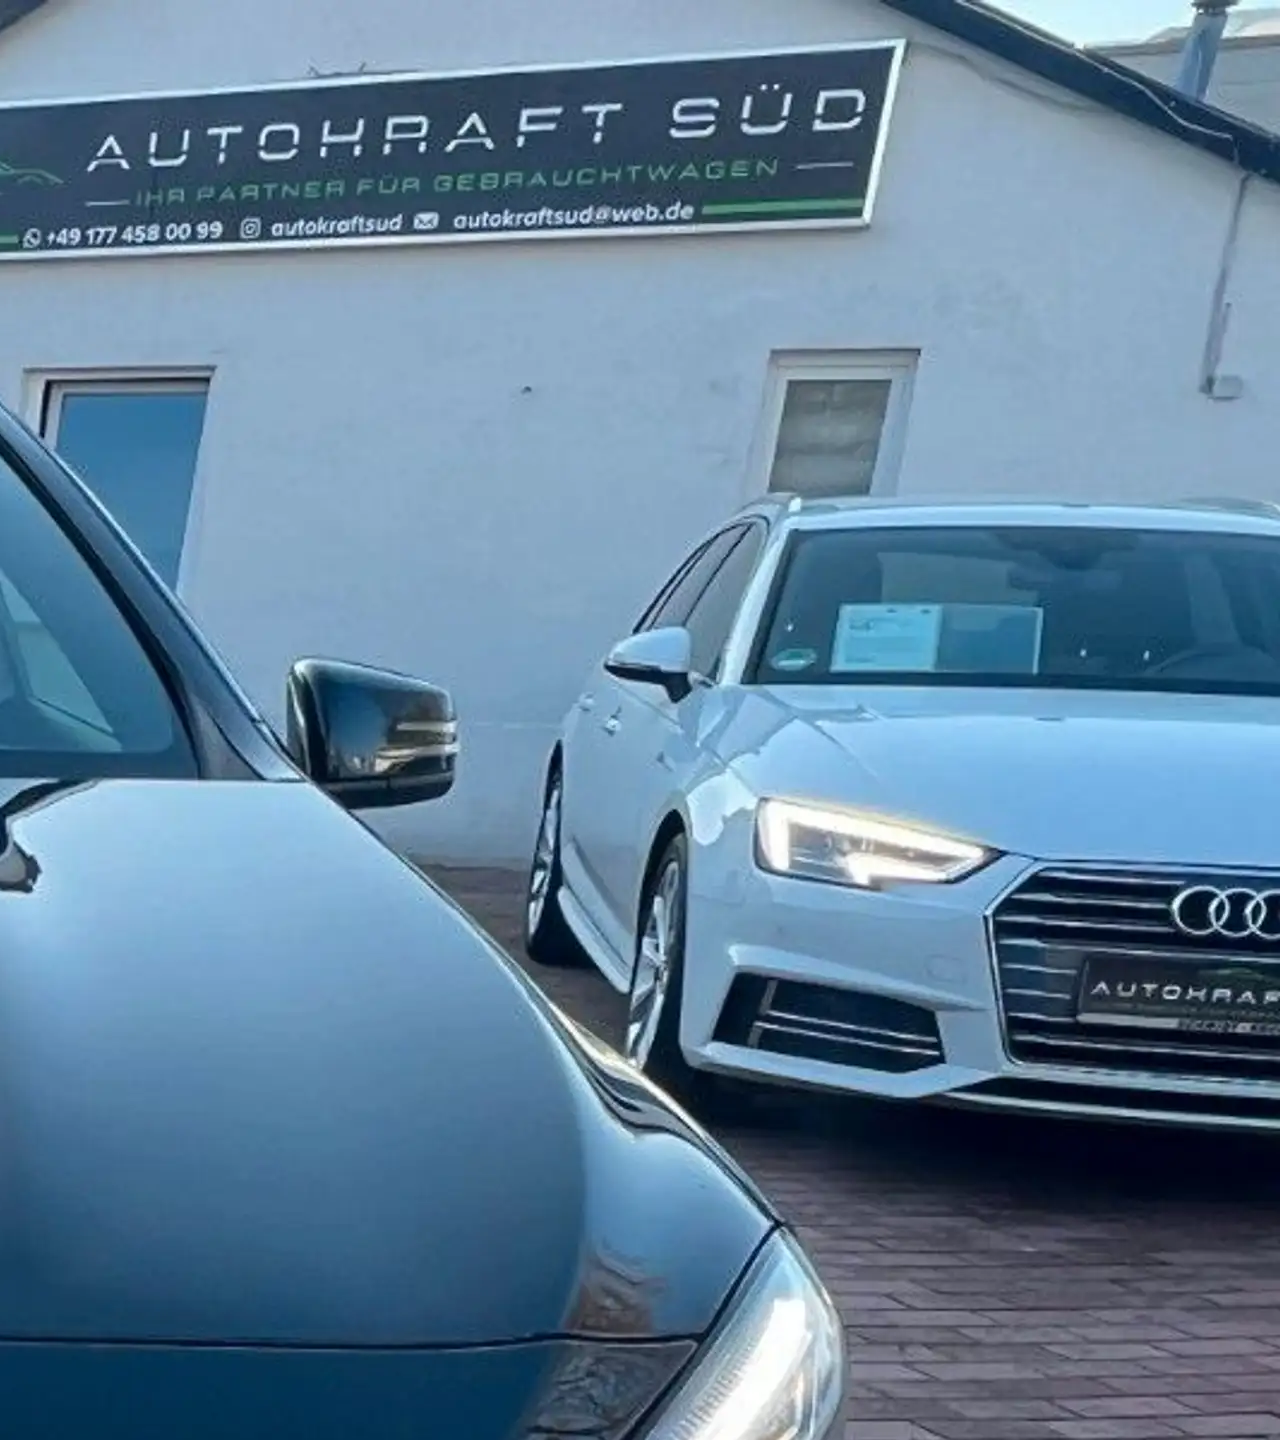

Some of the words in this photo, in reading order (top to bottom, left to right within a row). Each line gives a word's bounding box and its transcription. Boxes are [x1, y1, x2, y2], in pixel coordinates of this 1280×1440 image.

[667, 83, 867, 139] SÜD
[136, 187, 186, 206] IHR
[196, 179, 345, 202] PARTNER
[433, 158, 780, 194] GEBRAUCHTWAGEN
[270, 213, 404, 237] autokraftsud
[452, 201, 695, 231] autokraftsud@web.de
[46, 228, 82, 247] +49
[86, 225, 118, 245] 177
[121, 223, 161, 244] 458
[165, 222, 191, 241] 00
[196, 219, 224, 239] 99
